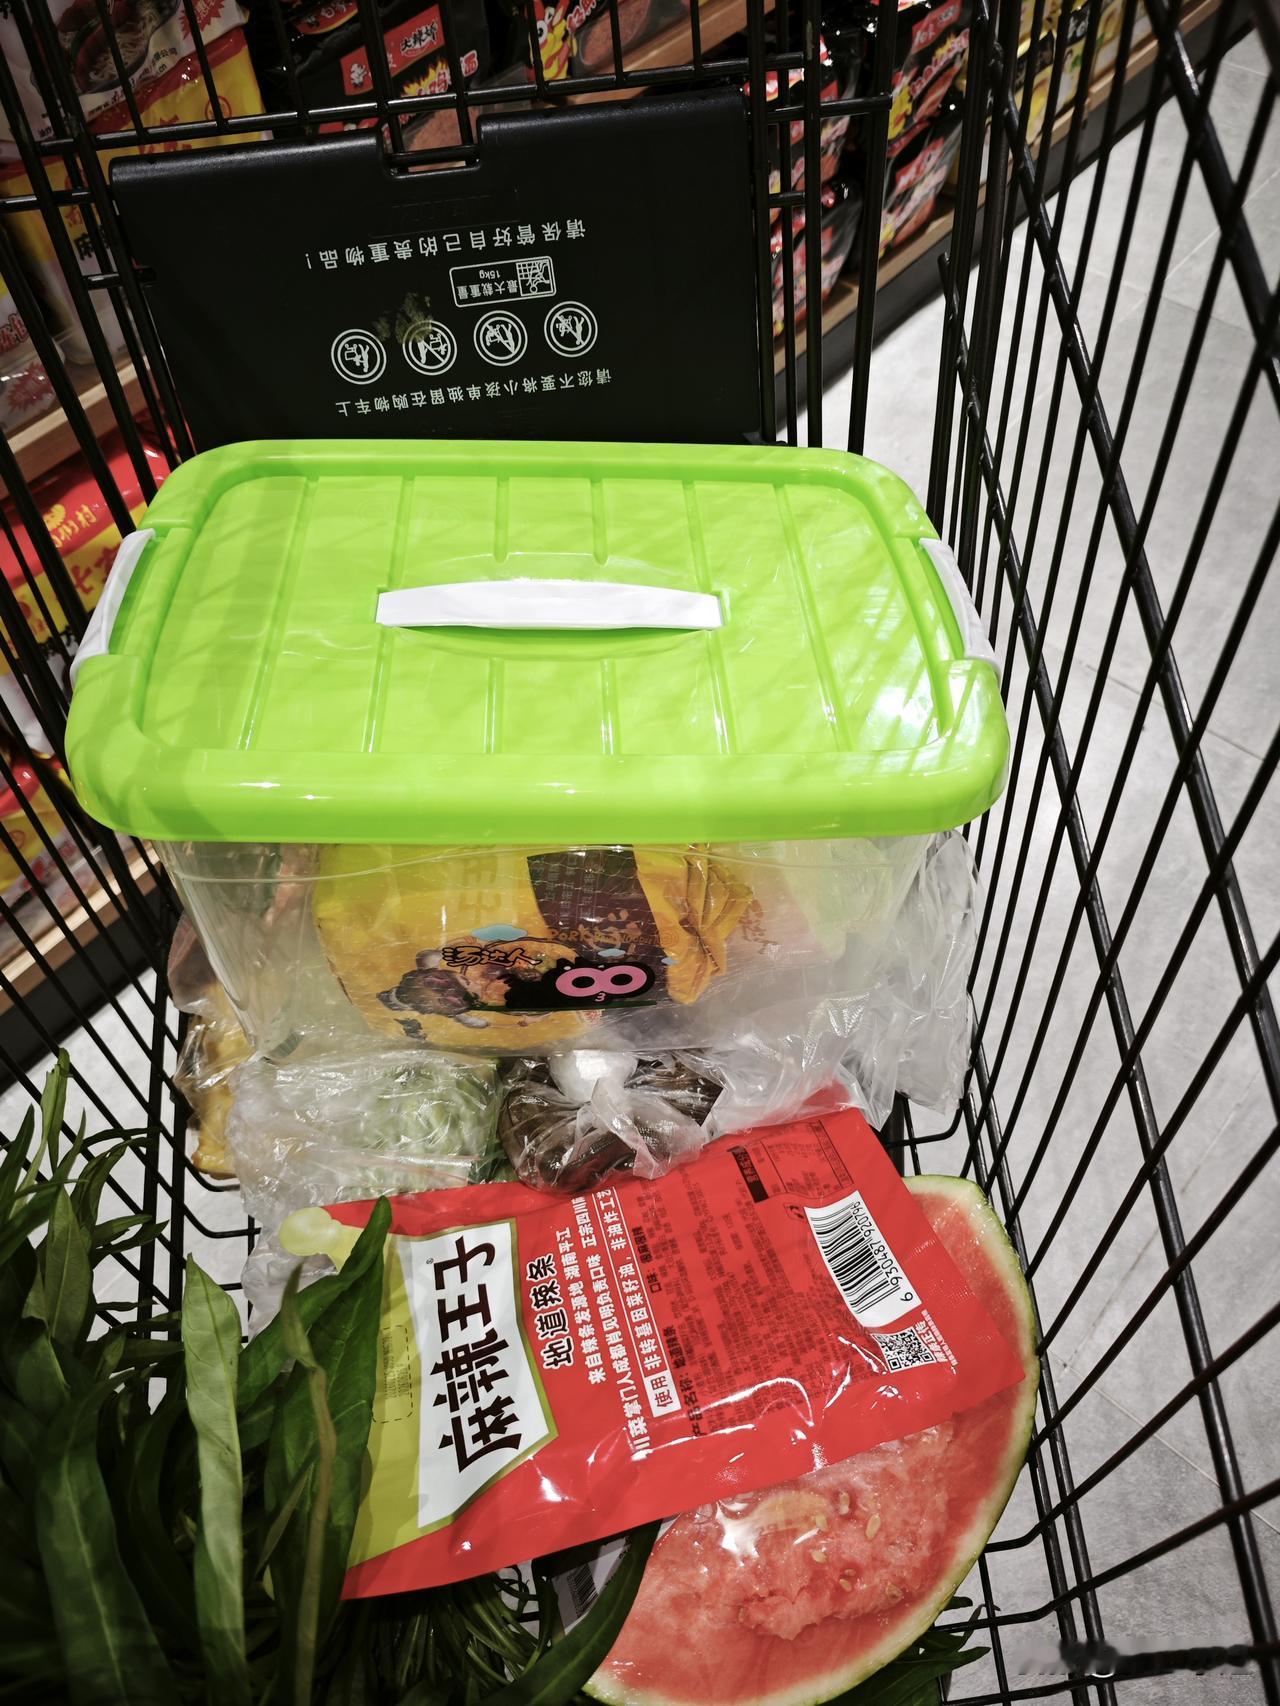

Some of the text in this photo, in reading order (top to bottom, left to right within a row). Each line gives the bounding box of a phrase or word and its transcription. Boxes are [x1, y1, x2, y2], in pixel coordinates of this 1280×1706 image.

[305, 218, 586, 270] 请保管好自己的贵重物品！
[457, 279, 519, 300] 最大载重量
[478, 269, 501, 281] 15kg
[335, 368, 612, 416] 请您不要将小孩单独留在购物车上
[442, 945, 542, 968] 汤达人
[852, 1201, 914, 1302] 6 930487 920796
[527, 1254, 574, 1370] 地道辣条
[556, 1227, 607, 1385] 来自辣条发源地 湖南平江
[430, 1235, 522, 1473] 麻辣王子
[650, 1375, 673, 1408] 使用
